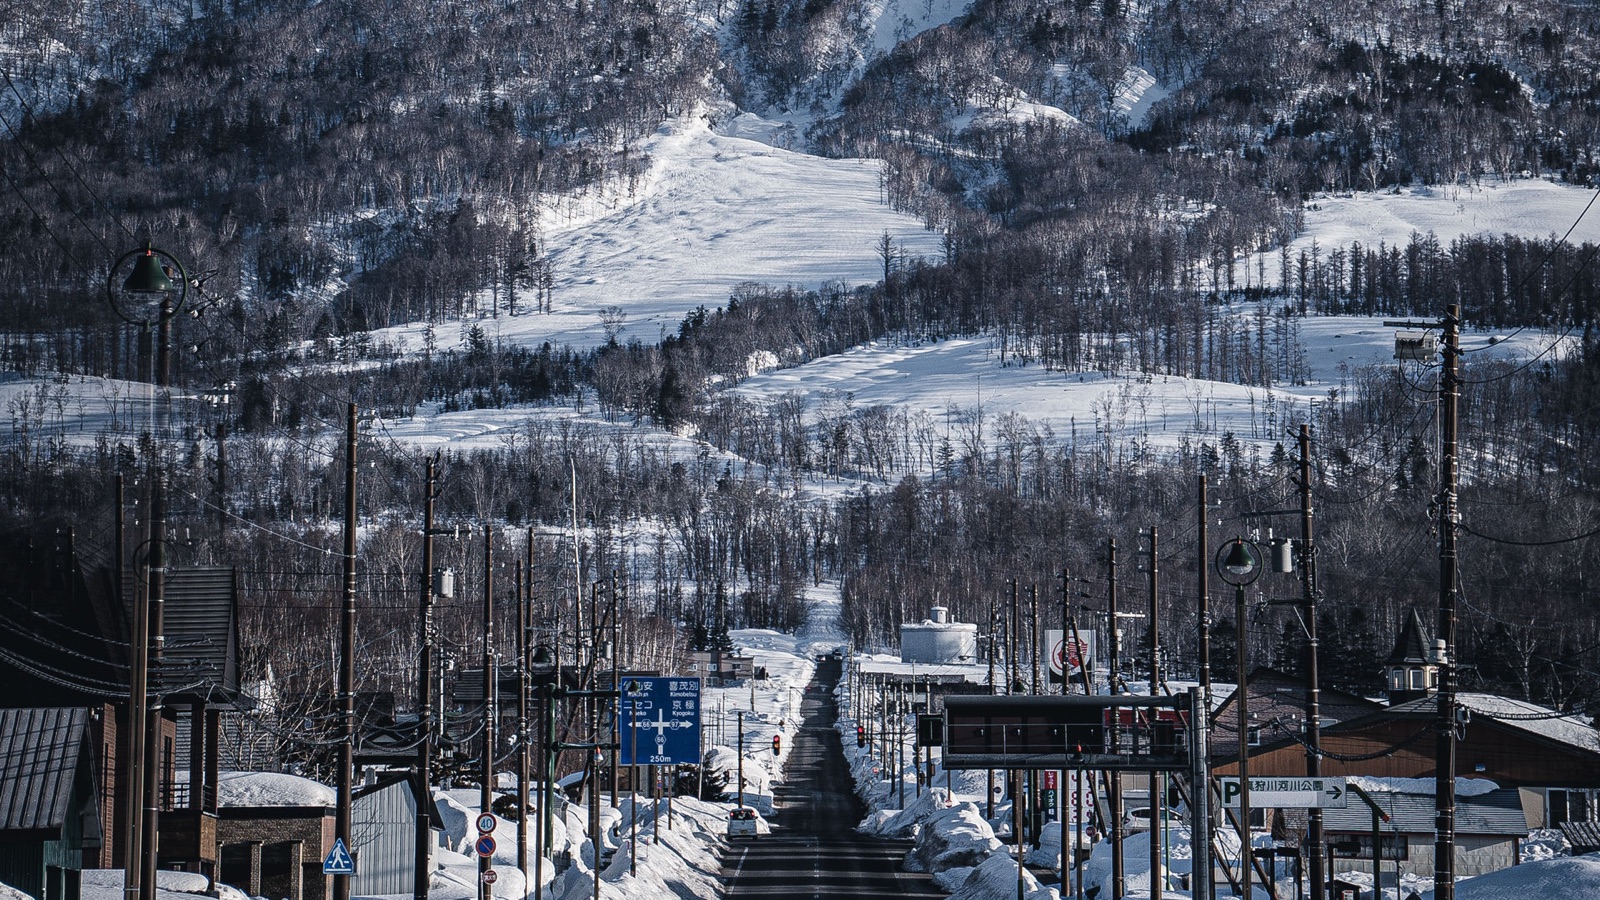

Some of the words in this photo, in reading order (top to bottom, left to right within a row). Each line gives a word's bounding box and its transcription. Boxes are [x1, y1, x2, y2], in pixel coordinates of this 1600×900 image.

[669, 681, 698, 691] 喜茂別
[623, 700, 653, 710] ニセコ
[650, 755, 671, 763] 250m
[1225, 781, 1240, 804] P
[481, 818, 493, 829] 40
